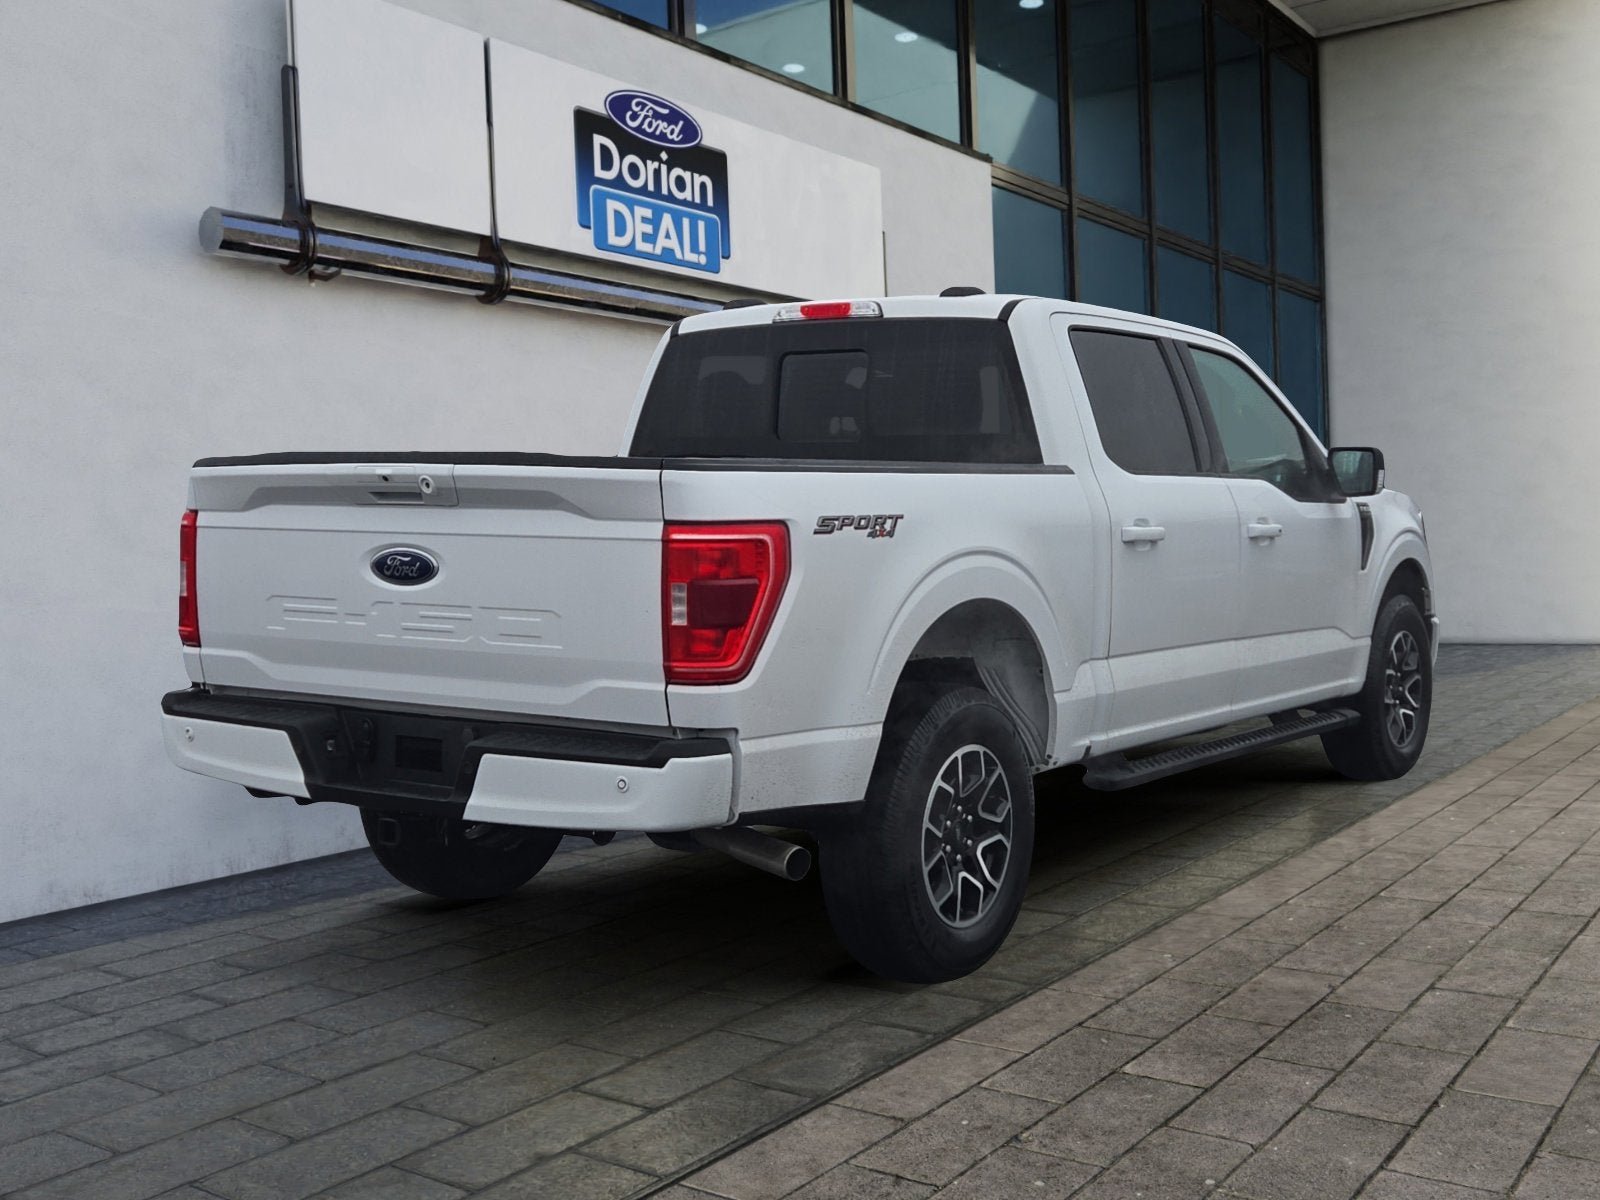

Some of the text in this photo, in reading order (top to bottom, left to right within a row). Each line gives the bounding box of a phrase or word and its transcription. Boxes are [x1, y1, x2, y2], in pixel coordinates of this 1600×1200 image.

[625, 97, 684, 142] Ford
[592, 133, 714, 207] Dorian
[605, 198, 707, 265] DEAL!
[813, 514, 904, 535] SPORT
[383, 555, 420, 577] Ford
[266, 595, 563, 649] F-150
